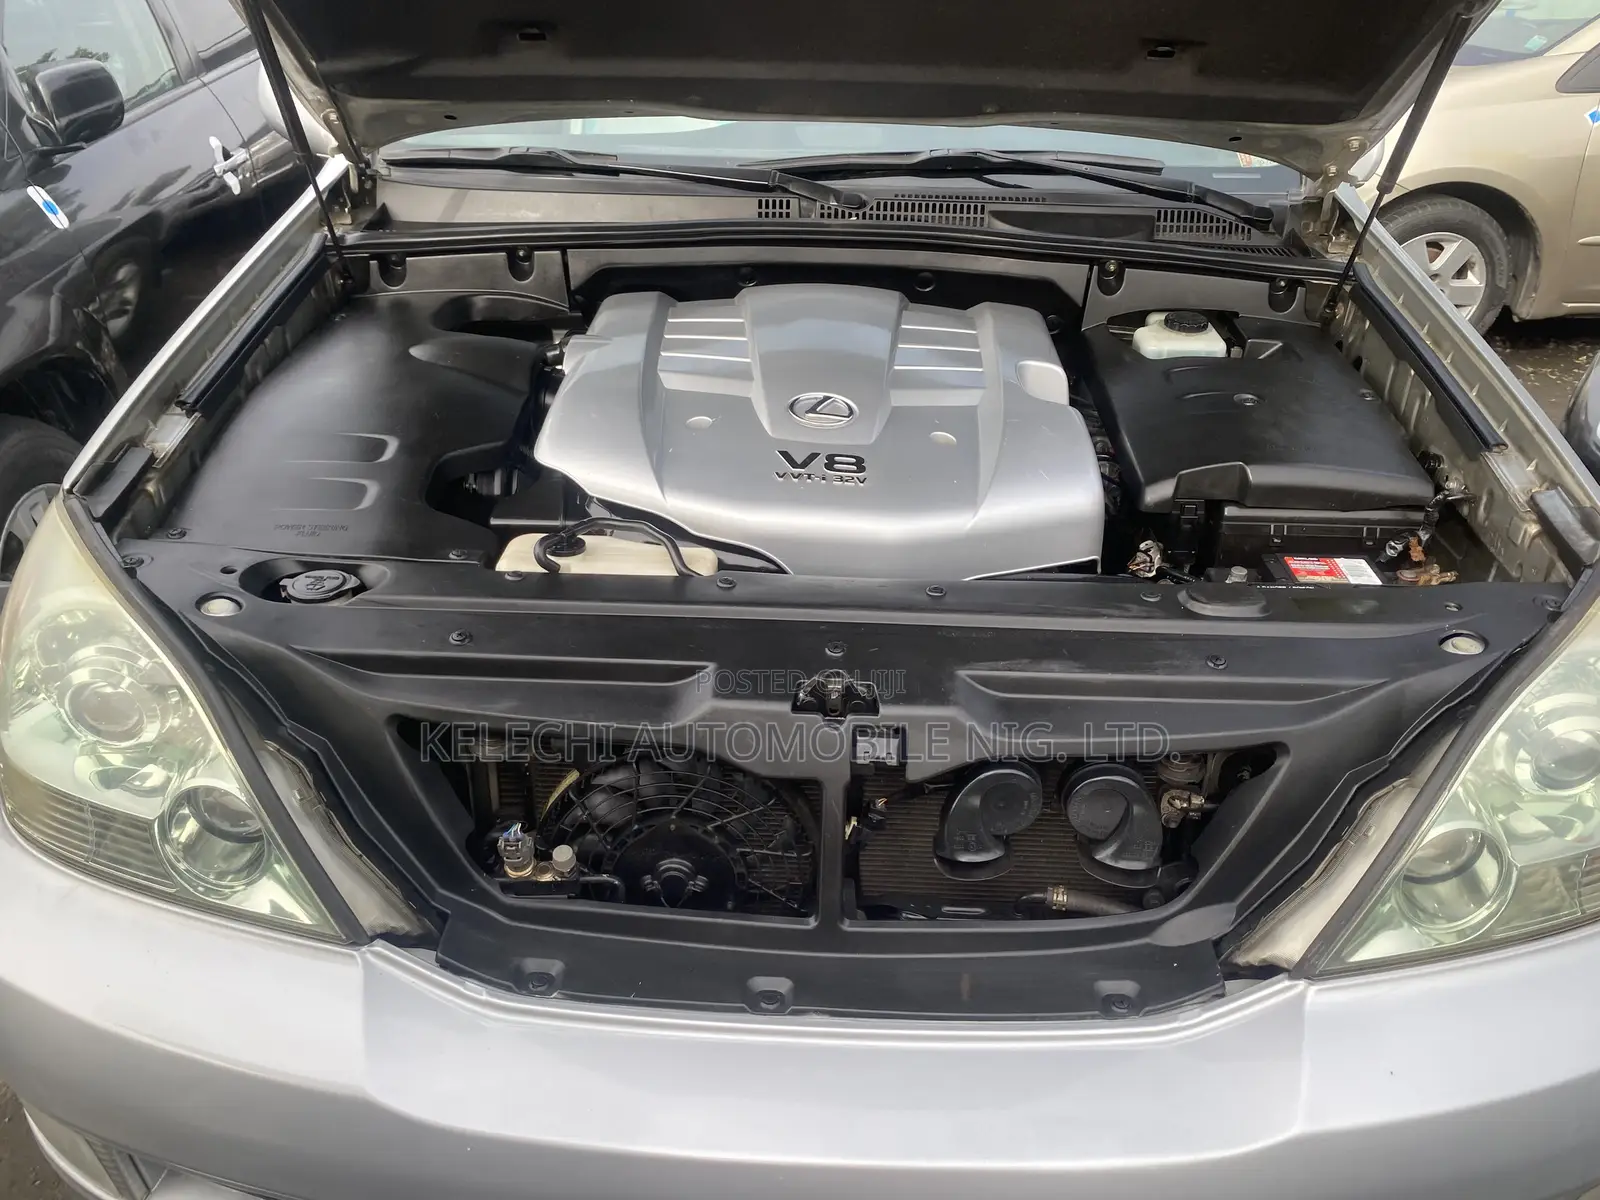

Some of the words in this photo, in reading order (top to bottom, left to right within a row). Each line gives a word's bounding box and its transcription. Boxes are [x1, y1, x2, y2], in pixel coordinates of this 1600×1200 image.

[775, 449, 867, 475] V8
[774, 471, 827, 484] VVT-i
[832, 474, 868, 486] 32V
